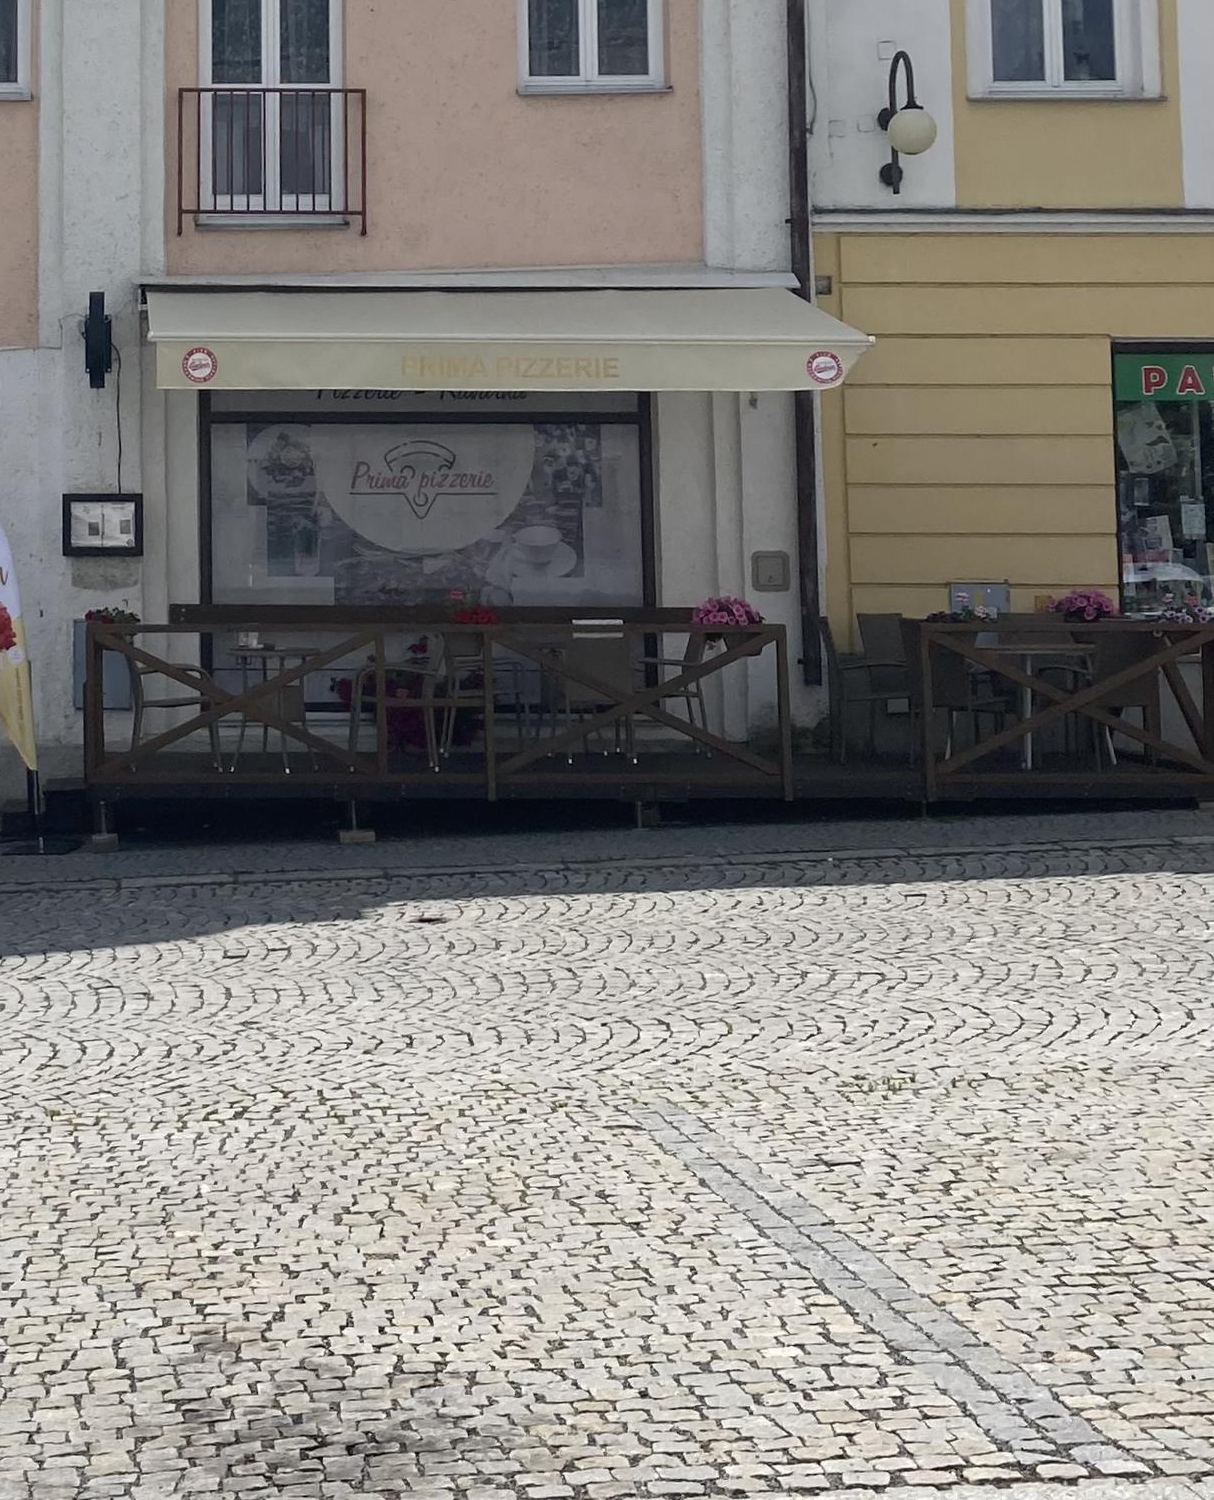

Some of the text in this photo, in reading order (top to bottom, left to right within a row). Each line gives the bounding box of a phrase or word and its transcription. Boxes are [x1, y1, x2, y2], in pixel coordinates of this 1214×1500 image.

[401, 355, 620, 379] PRIMA PIZZERIE
[1141, 365, 1214, 395] PA
[351, 461, 495, 498] Prima pizzerie
